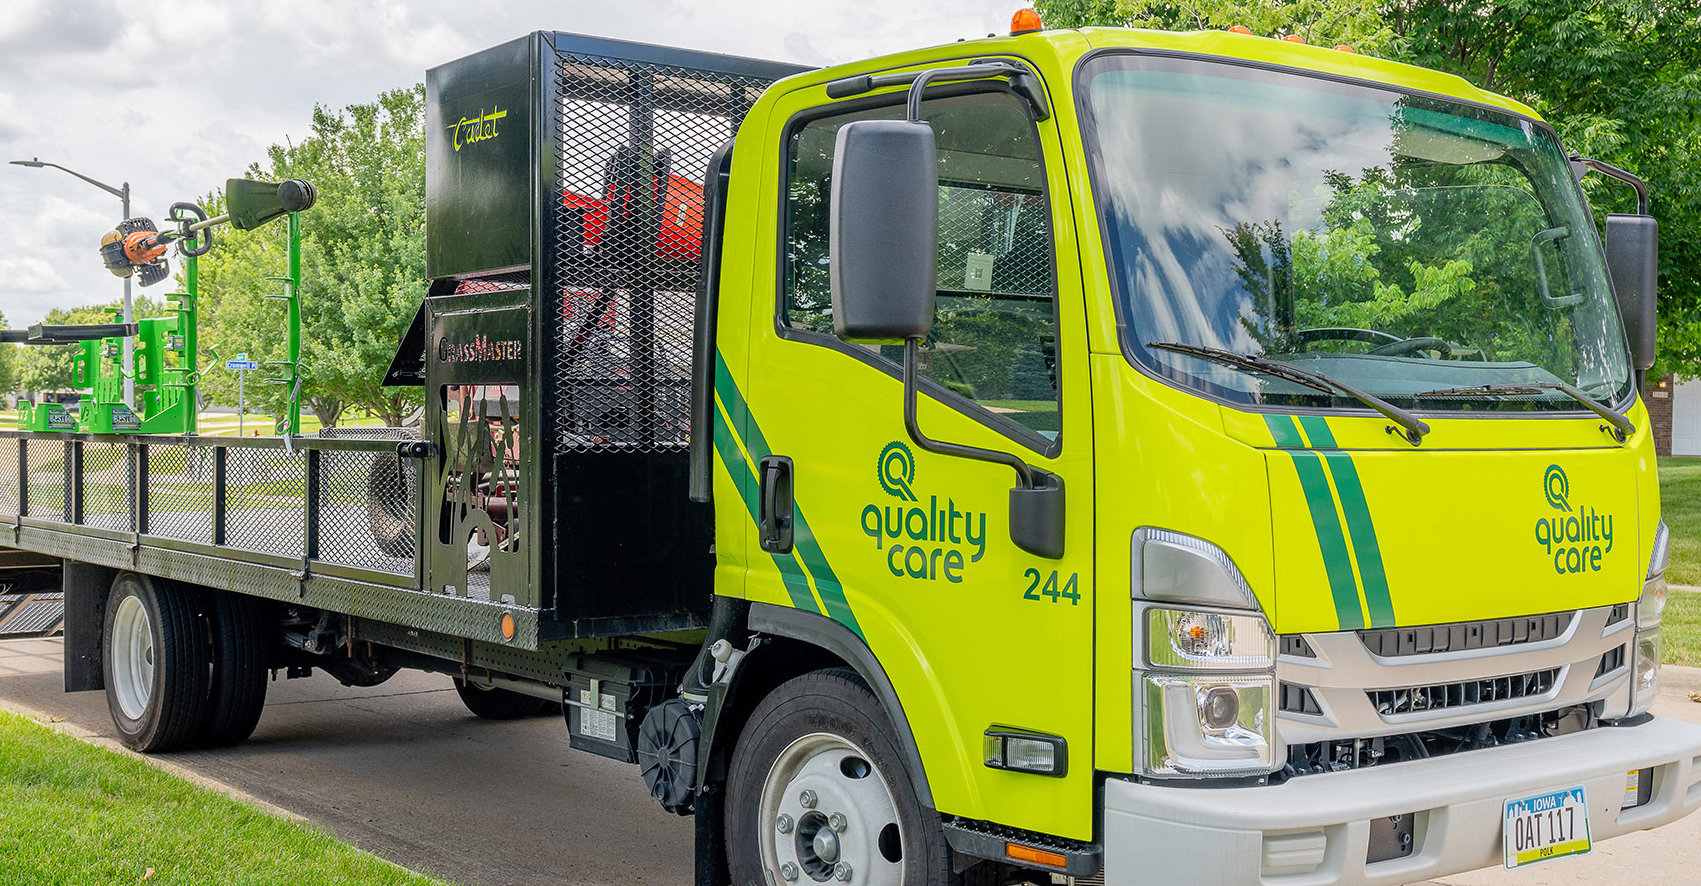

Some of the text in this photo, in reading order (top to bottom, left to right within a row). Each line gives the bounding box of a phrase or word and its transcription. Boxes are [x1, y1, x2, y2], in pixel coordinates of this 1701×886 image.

[444, 105, 507, 152] Cadet
[861, 495, 987, 563] quality
[1535, 505, 1613, 555] quality
[887, 544, 965, 584] care
[1554, 545, 1602, 575] care
[1023, 567, 1082, 607] 244
[1533, 796, 1557, 812] IOWA
[1515, 806, 1574, 852] OAT 117
[1540, 846, 1555, 857] POLK
